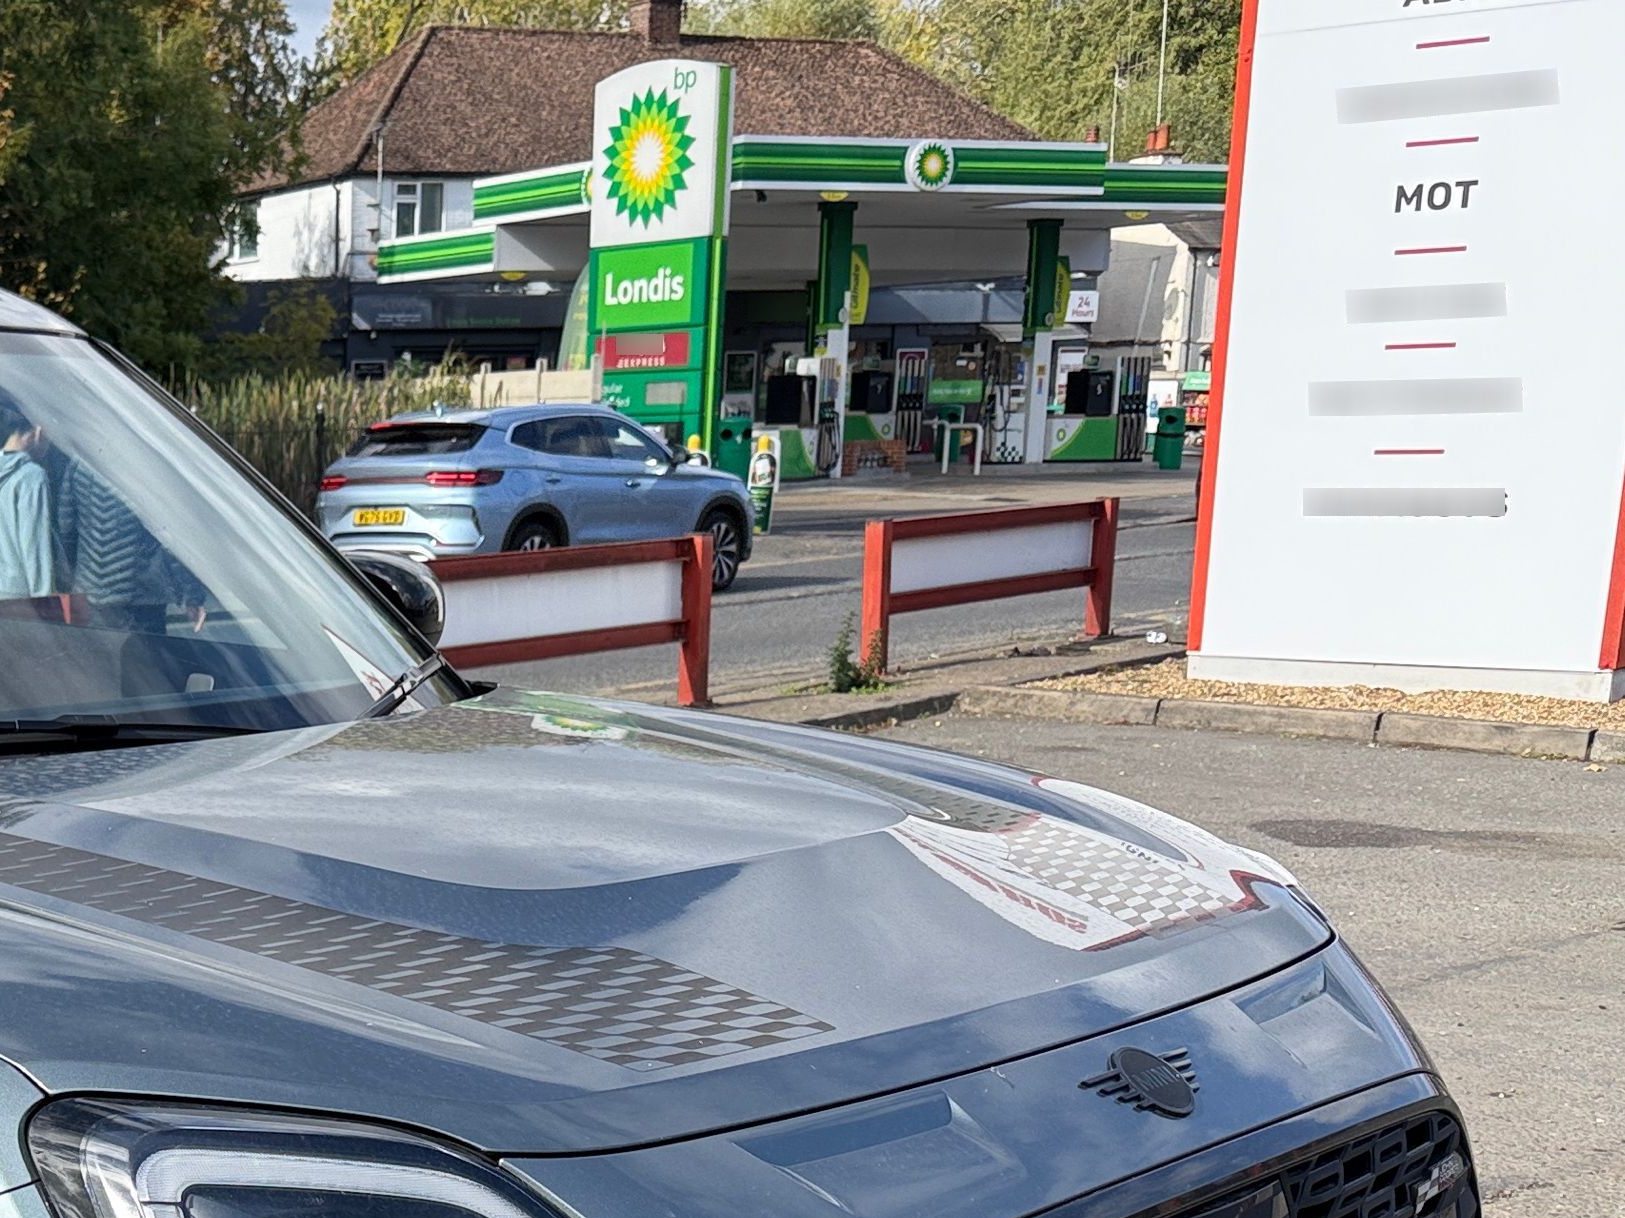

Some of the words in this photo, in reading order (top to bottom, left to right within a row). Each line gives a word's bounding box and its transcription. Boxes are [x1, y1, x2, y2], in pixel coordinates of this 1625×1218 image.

[673, 66, 697, 94] bp
[1394, 180, 1478, 213] MOT
[604, 266, 685, 306] Londis
[1071, 308, 1095, 317] Hours
[1078, 296, 1091, 308] 24
[1131, 1064, 1178, 1092] MINI
